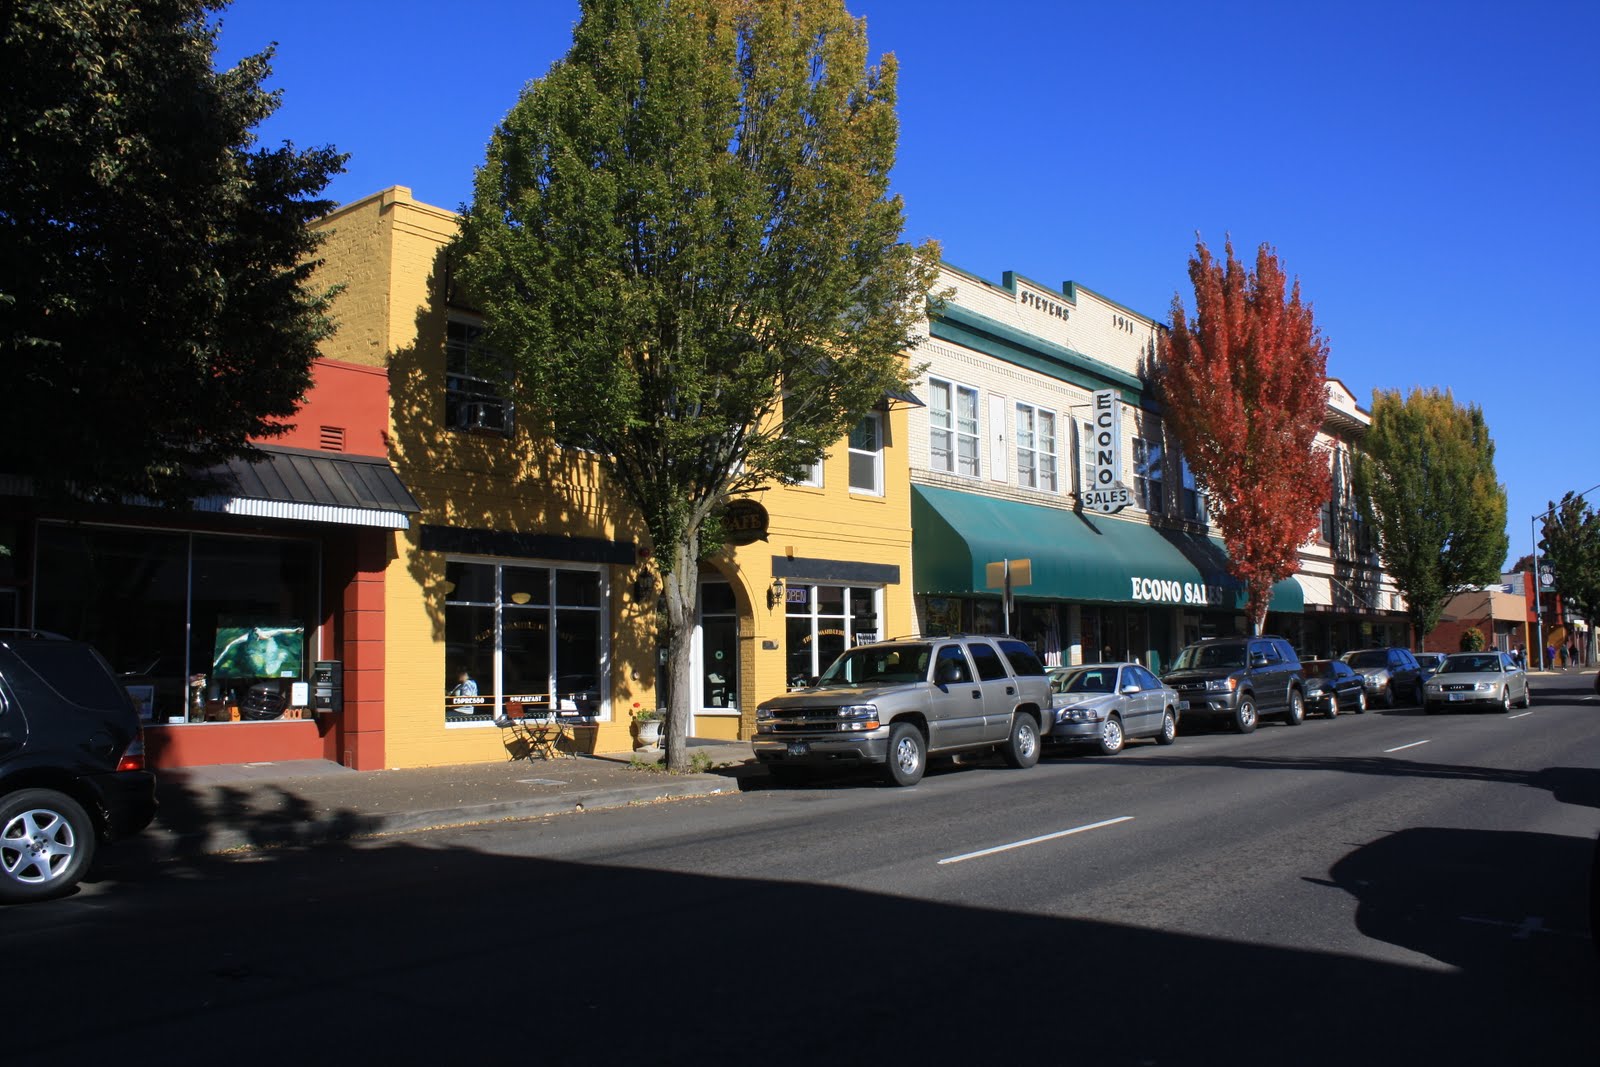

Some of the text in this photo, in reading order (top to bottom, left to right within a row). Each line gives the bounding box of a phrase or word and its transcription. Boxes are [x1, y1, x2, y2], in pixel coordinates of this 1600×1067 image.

[1021, 290, 1069, 321] STEVENS
[1112, 314, 1133, 335] 1911
[1097, 393, 1112, 484] ECONO
[1085, 490, 1127, 505] SALES
[786, 589, 805, 602] OPEN
[1131, 577, 1182, 603] ECONO
